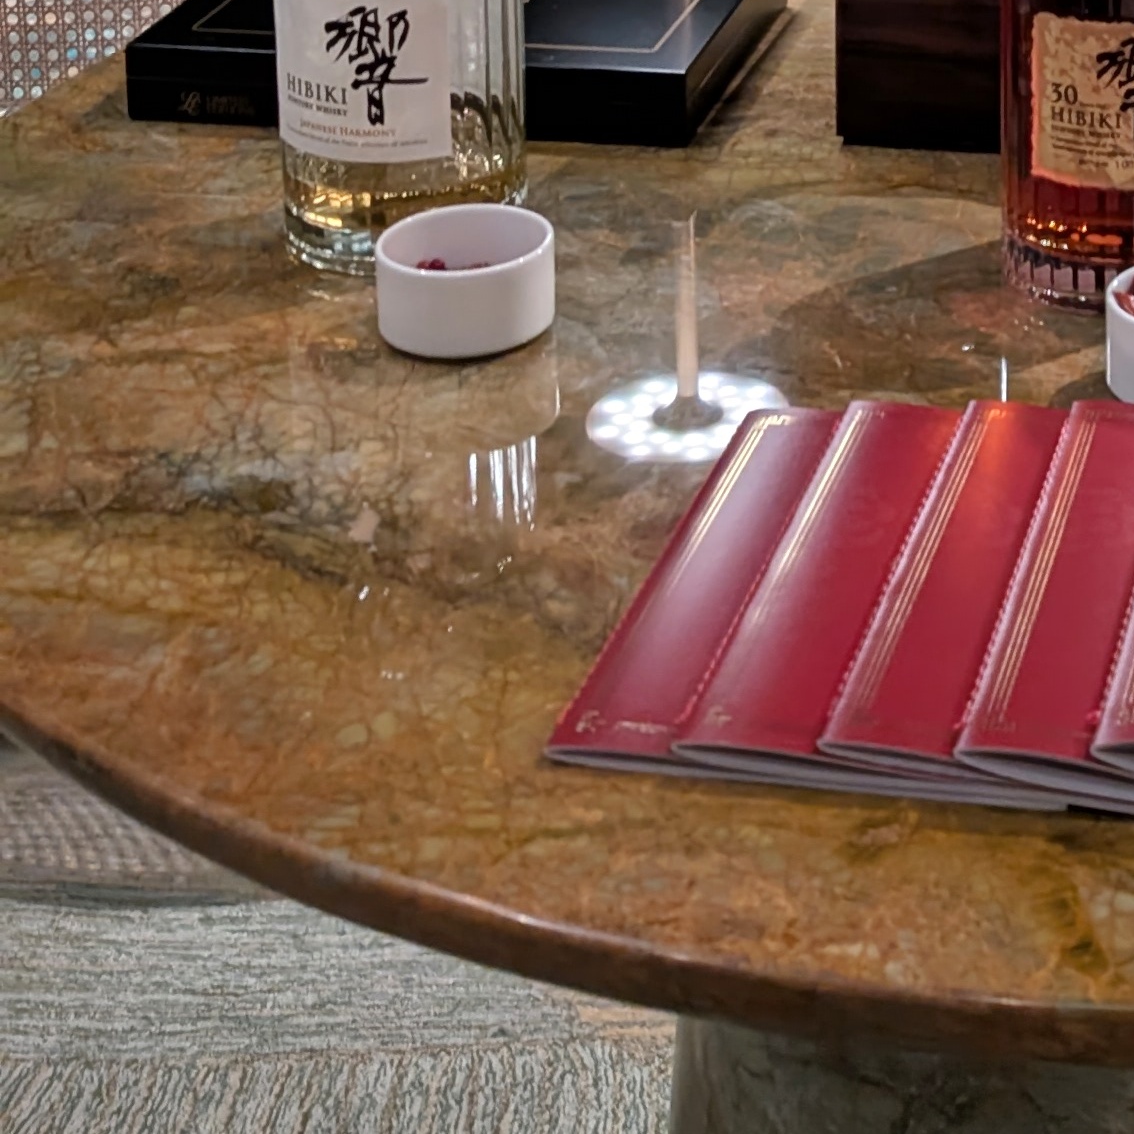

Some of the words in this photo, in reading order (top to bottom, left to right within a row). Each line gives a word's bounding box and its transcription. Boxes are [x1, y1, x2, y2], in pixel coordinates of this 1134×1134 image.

[286, 72, 348, 105] HIBIKI
[1050, 82, 1078, 105] 30
[316, 105, 349, 117] WHISKY
[1050, 105, 1122, 130] HIBIKI
[340, 127, 397, 139] HARMONY
